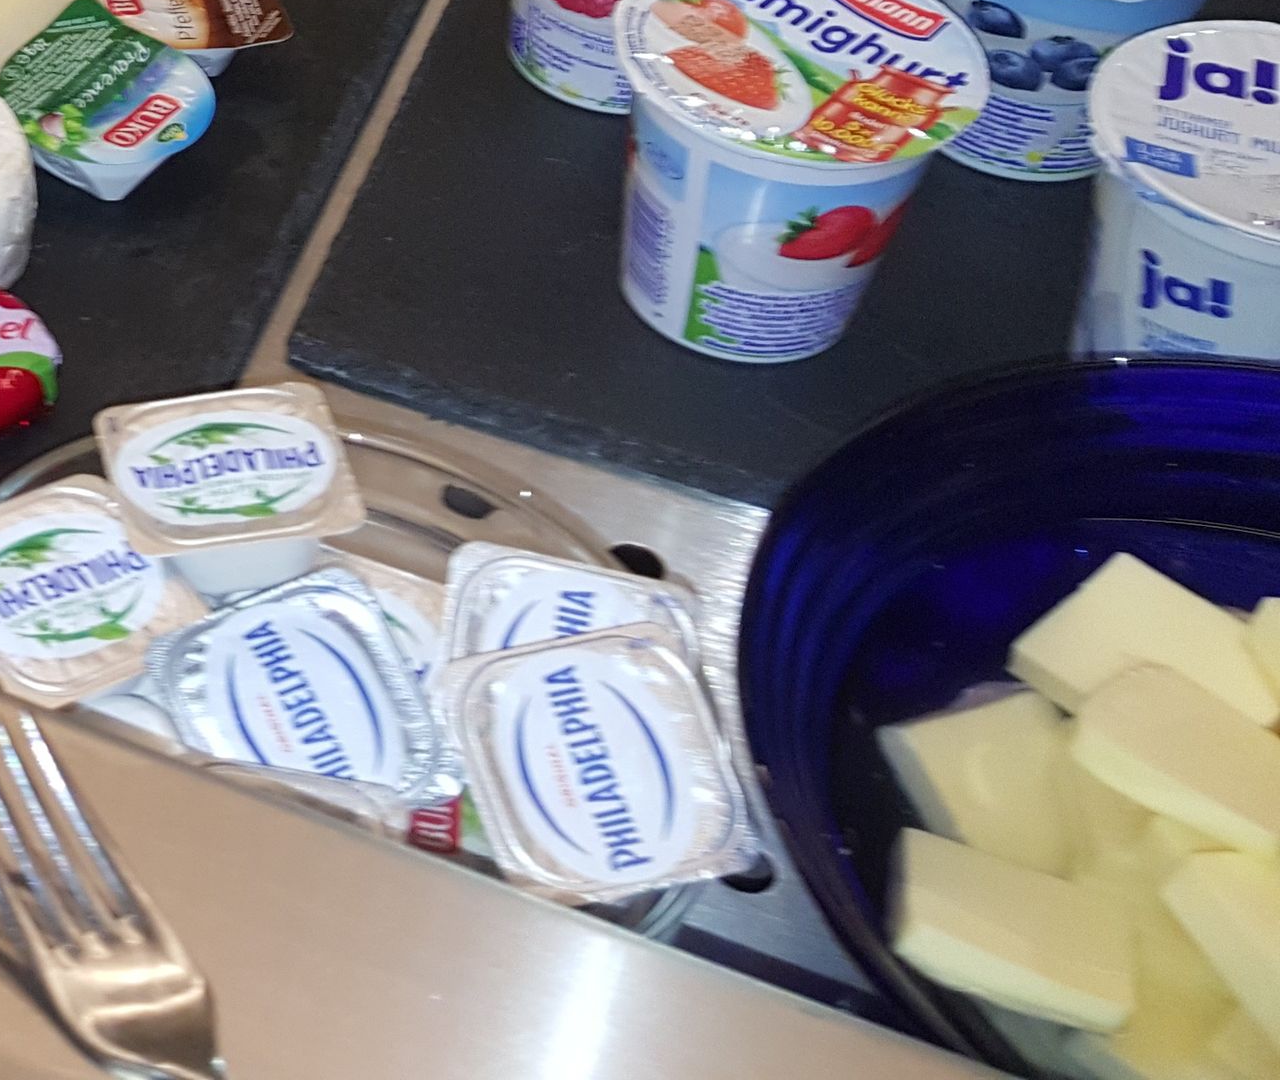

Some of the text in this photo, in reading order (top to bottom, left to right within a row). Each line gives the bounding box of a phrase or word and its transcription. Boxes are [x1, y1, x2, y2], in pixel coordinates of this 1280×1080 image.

[72, 40, 151, 109] Provence
[1157, 36, 1279, 105] ja!
[111, 98, 177, 145] BUKO
[1140, 247, 1234, 318] ja!
[130, 439, 326, 489] PHILADELPHIA
[242, 619, 355, 780] HILADELPHIA
[543, 664, 655, 873] PHILADELPHIA
